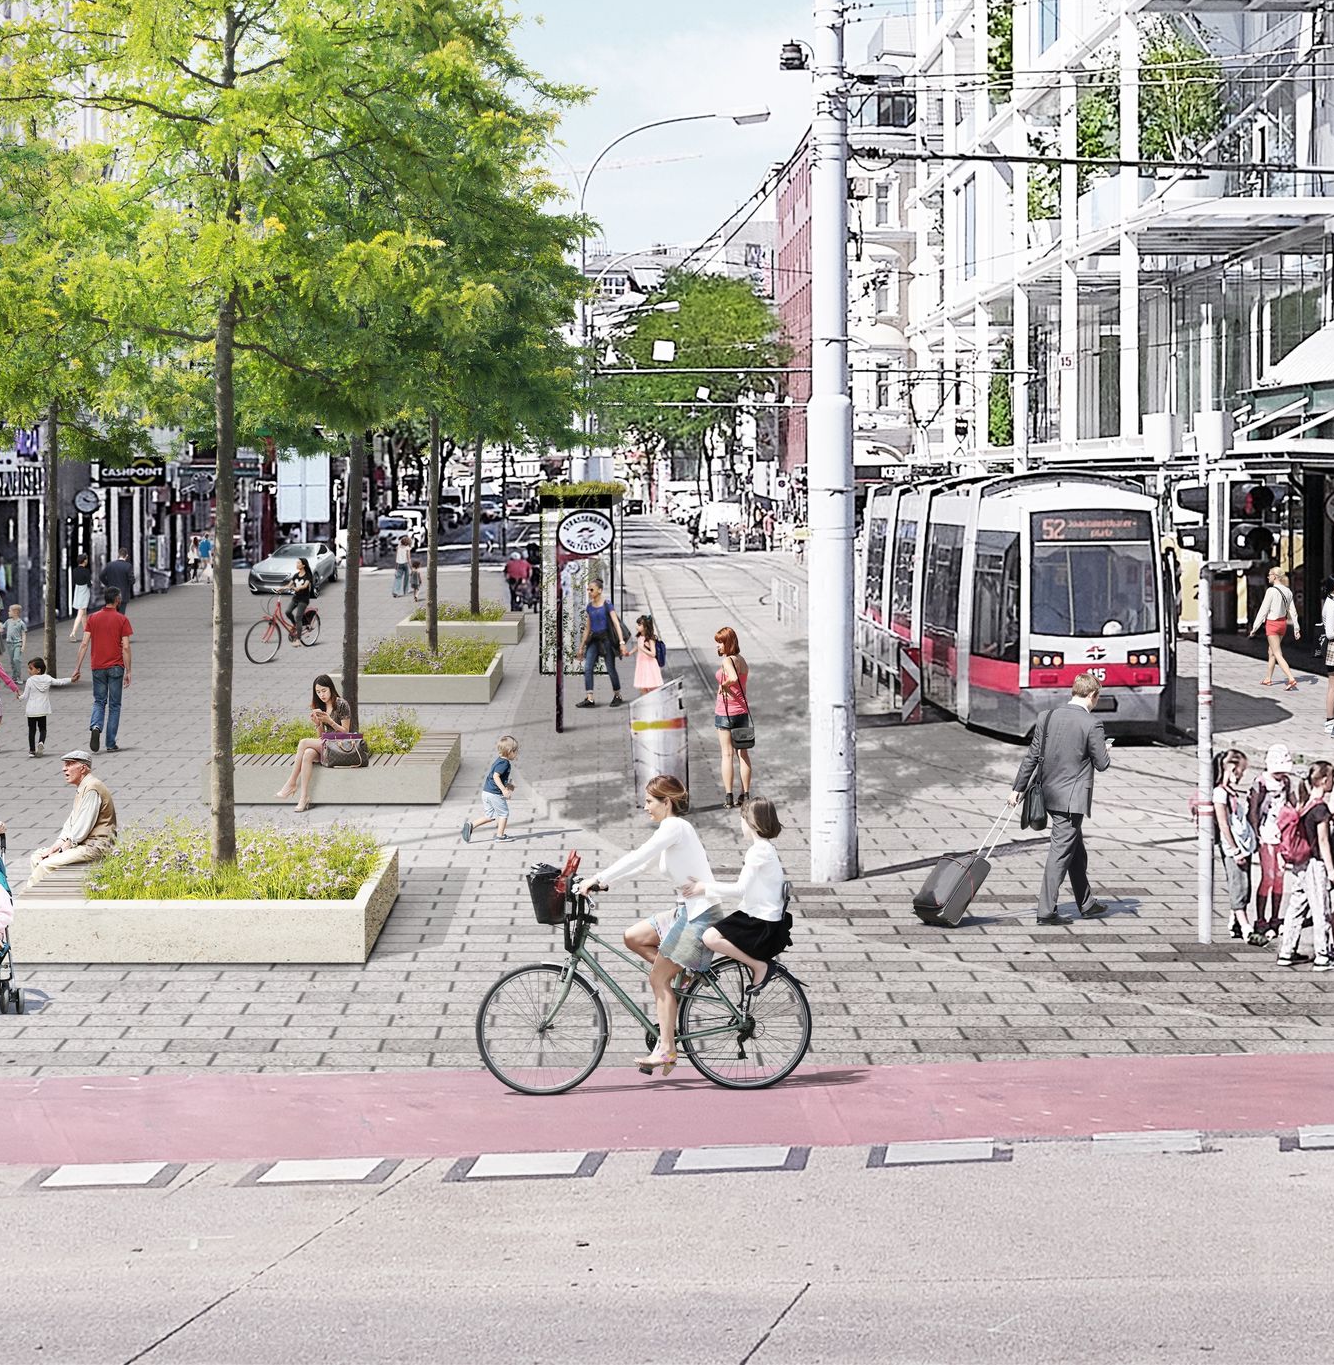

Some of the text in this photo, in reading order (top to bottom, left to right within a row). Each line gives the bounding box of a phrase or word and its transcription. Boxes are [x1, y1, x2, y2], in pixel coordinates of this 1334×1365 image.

[1061, 356, 1071, 366] 15
[101, 467, 163, 477] CASHPOINT
[1042, 518, 1066, 539] 52
